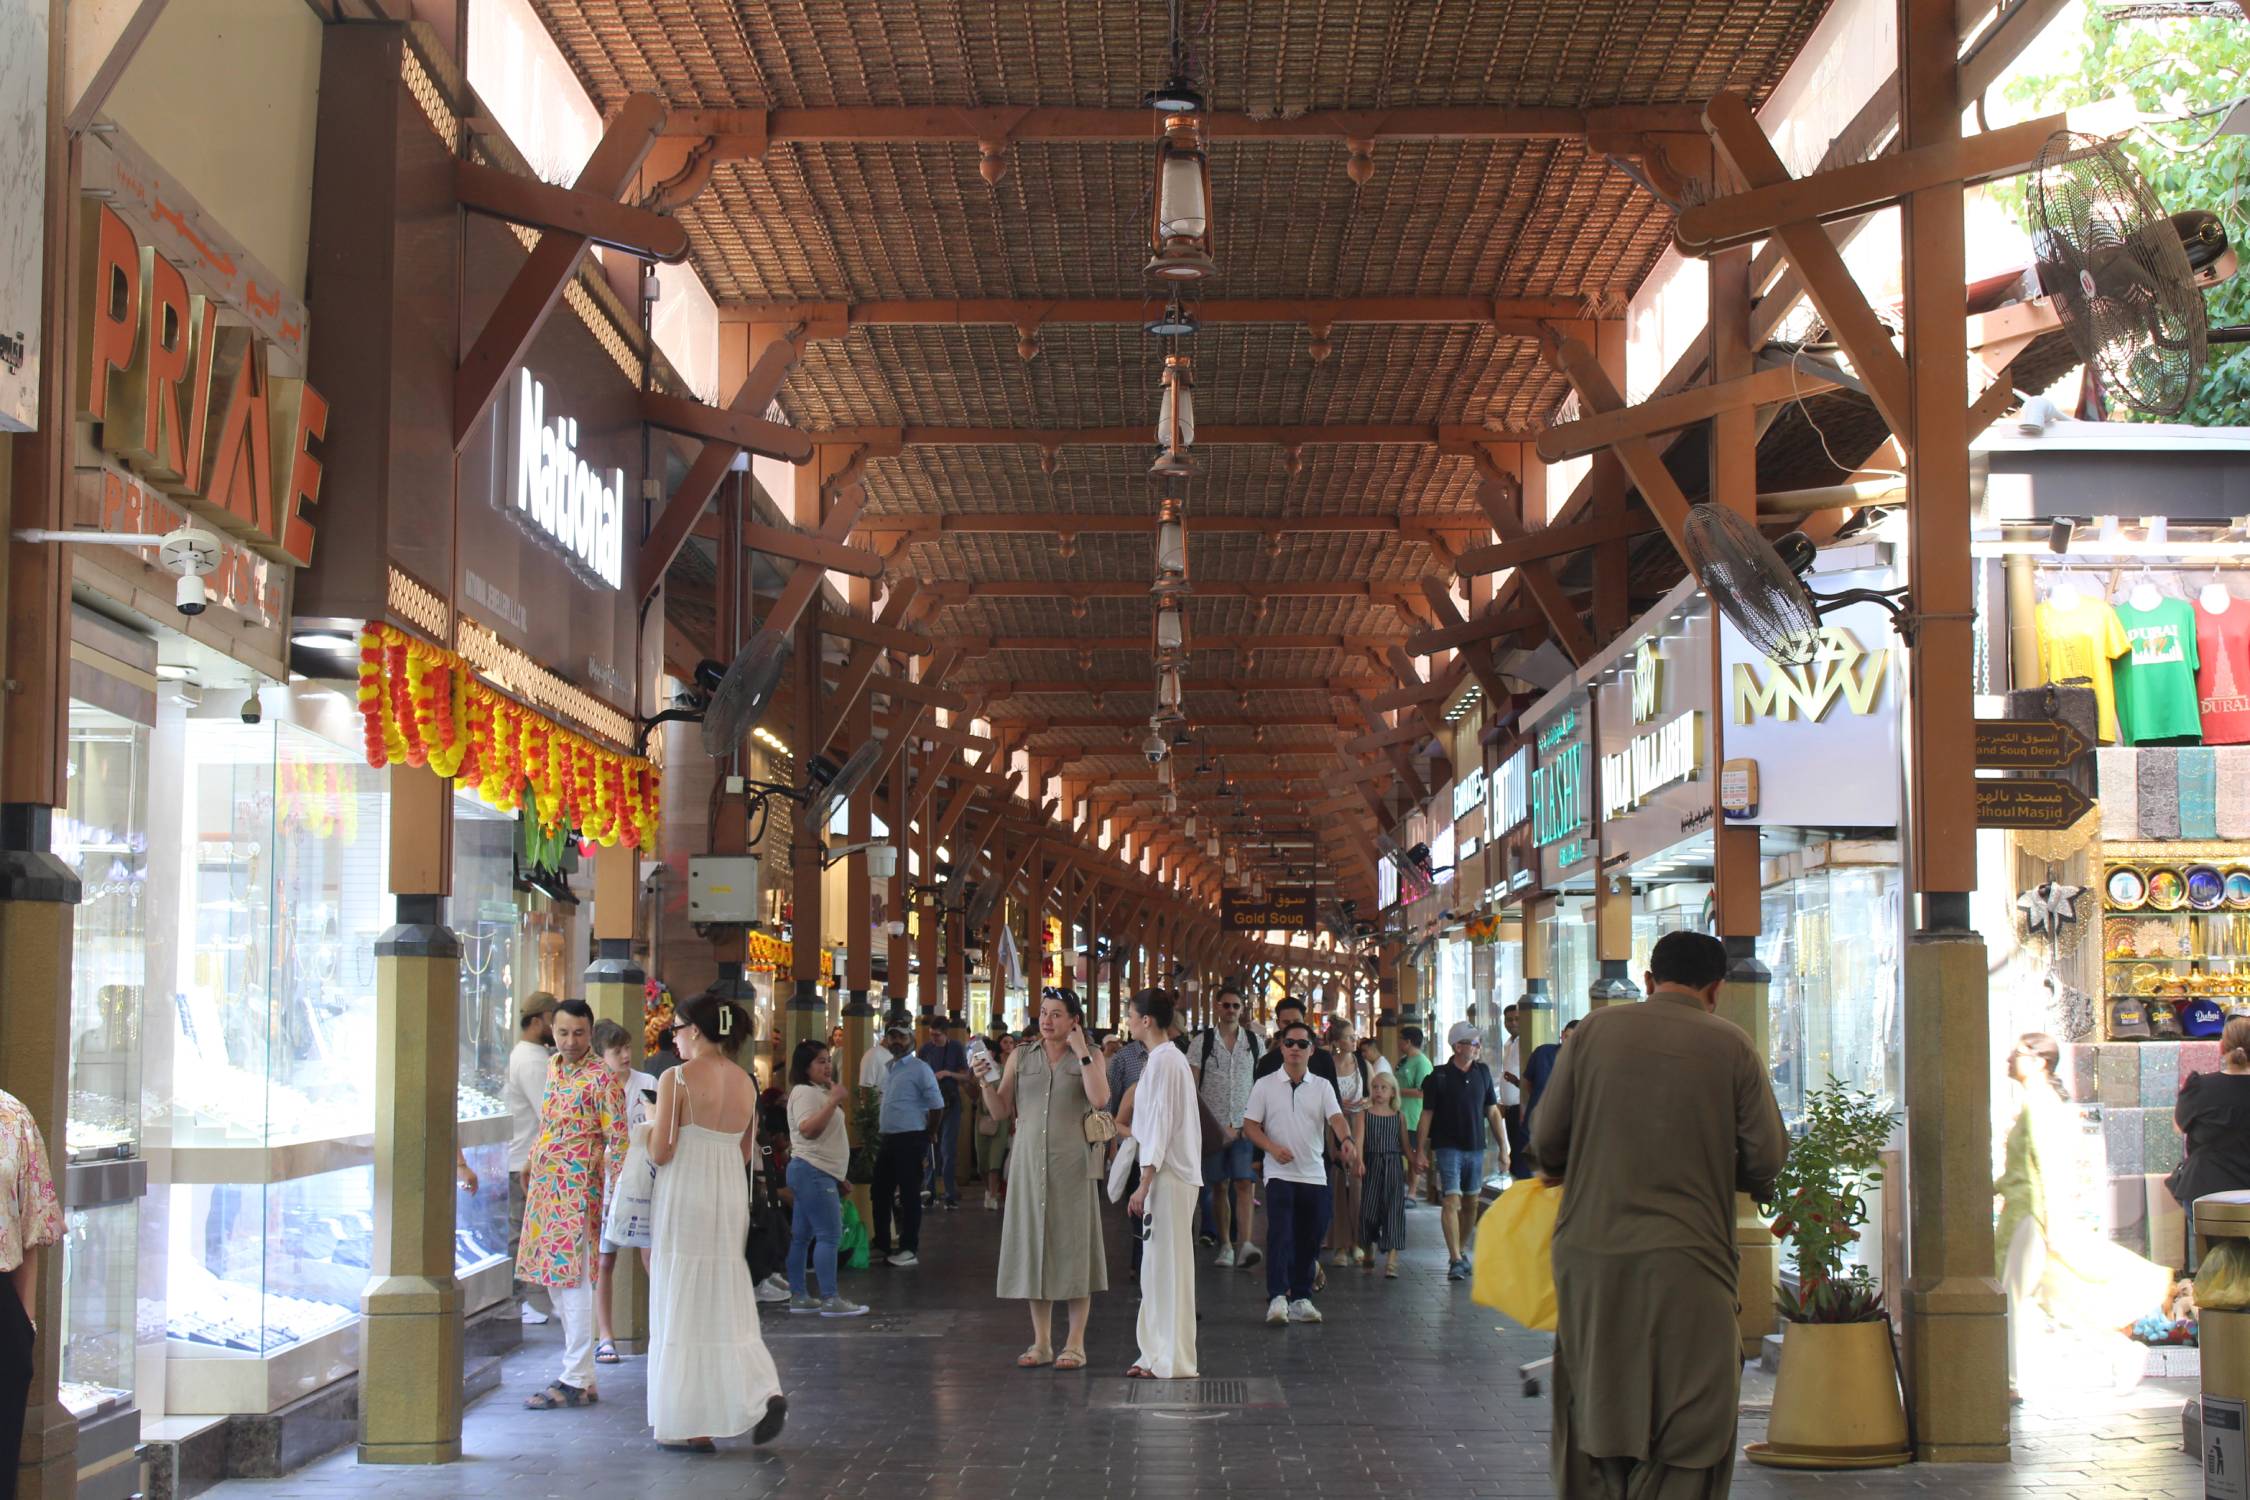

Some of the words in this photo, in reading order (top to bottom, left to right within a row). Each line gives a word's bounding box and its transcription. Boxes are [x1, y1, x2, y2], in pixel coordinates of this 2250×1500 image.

[89, 201, 328, 565] PRIME
[517, 366, 624, 591] National
[2127, 624, 2178, 641] DUBAI
[2022, 733, 2059, 744] السوق
[1976, 746, 1997, 755] and
[2000, 746, 2027, 757] Souq
[2031, 746, 2060, 755] Deira
[1532, 741, 1584, 848] FLASHY
[1976, 789, 2009, 805] بالهو
[2016, 791, 2063, 803] مسجد
[1976, 806, 2015, 817] elhoul
[2018, 806, 2063, 819] Masjid
[1234, 912, 1265, 925] Gold
[1270, 912, 1304, 926] Souq
[2194, 1009, 2220, 1023] Dubai
